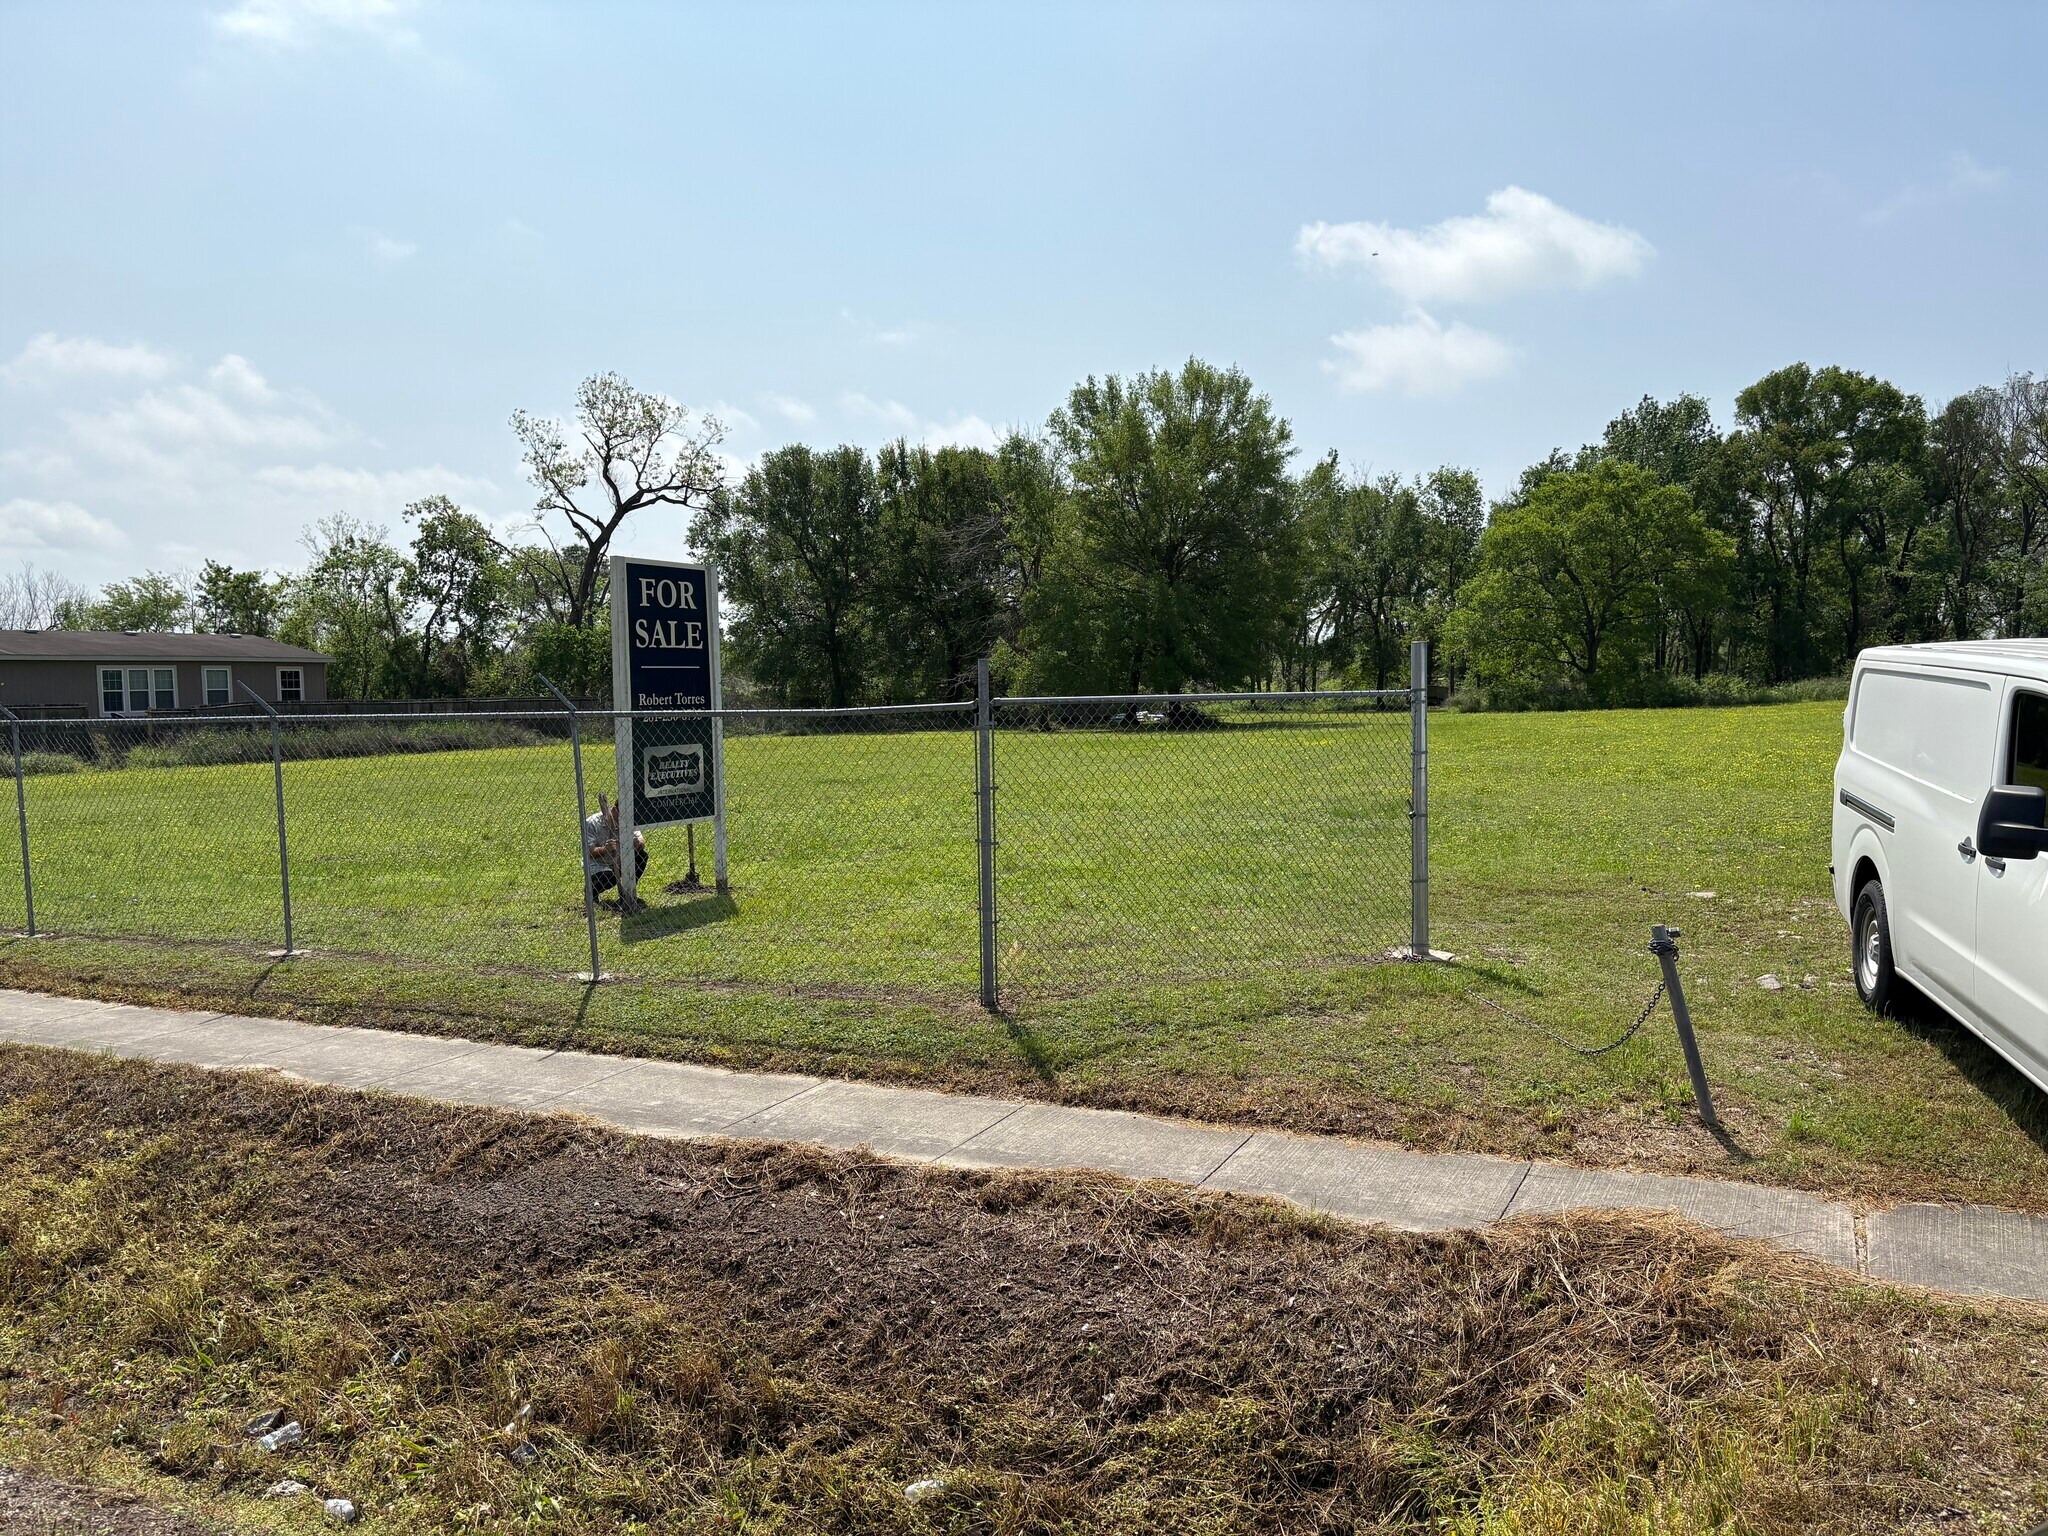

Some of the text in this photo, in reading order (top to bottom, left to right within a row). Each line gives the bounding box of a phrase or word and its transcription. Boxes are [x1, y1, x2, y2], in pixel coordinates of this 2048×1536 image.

[639, 577, 697, 610] FOR
[636, 619, 703, 650] SALE
[638, 692, 705, 706] Robert Torres
[659, 759, 689, 769] REALTY
[650, 769, 698, 782] EXECUTIVES
